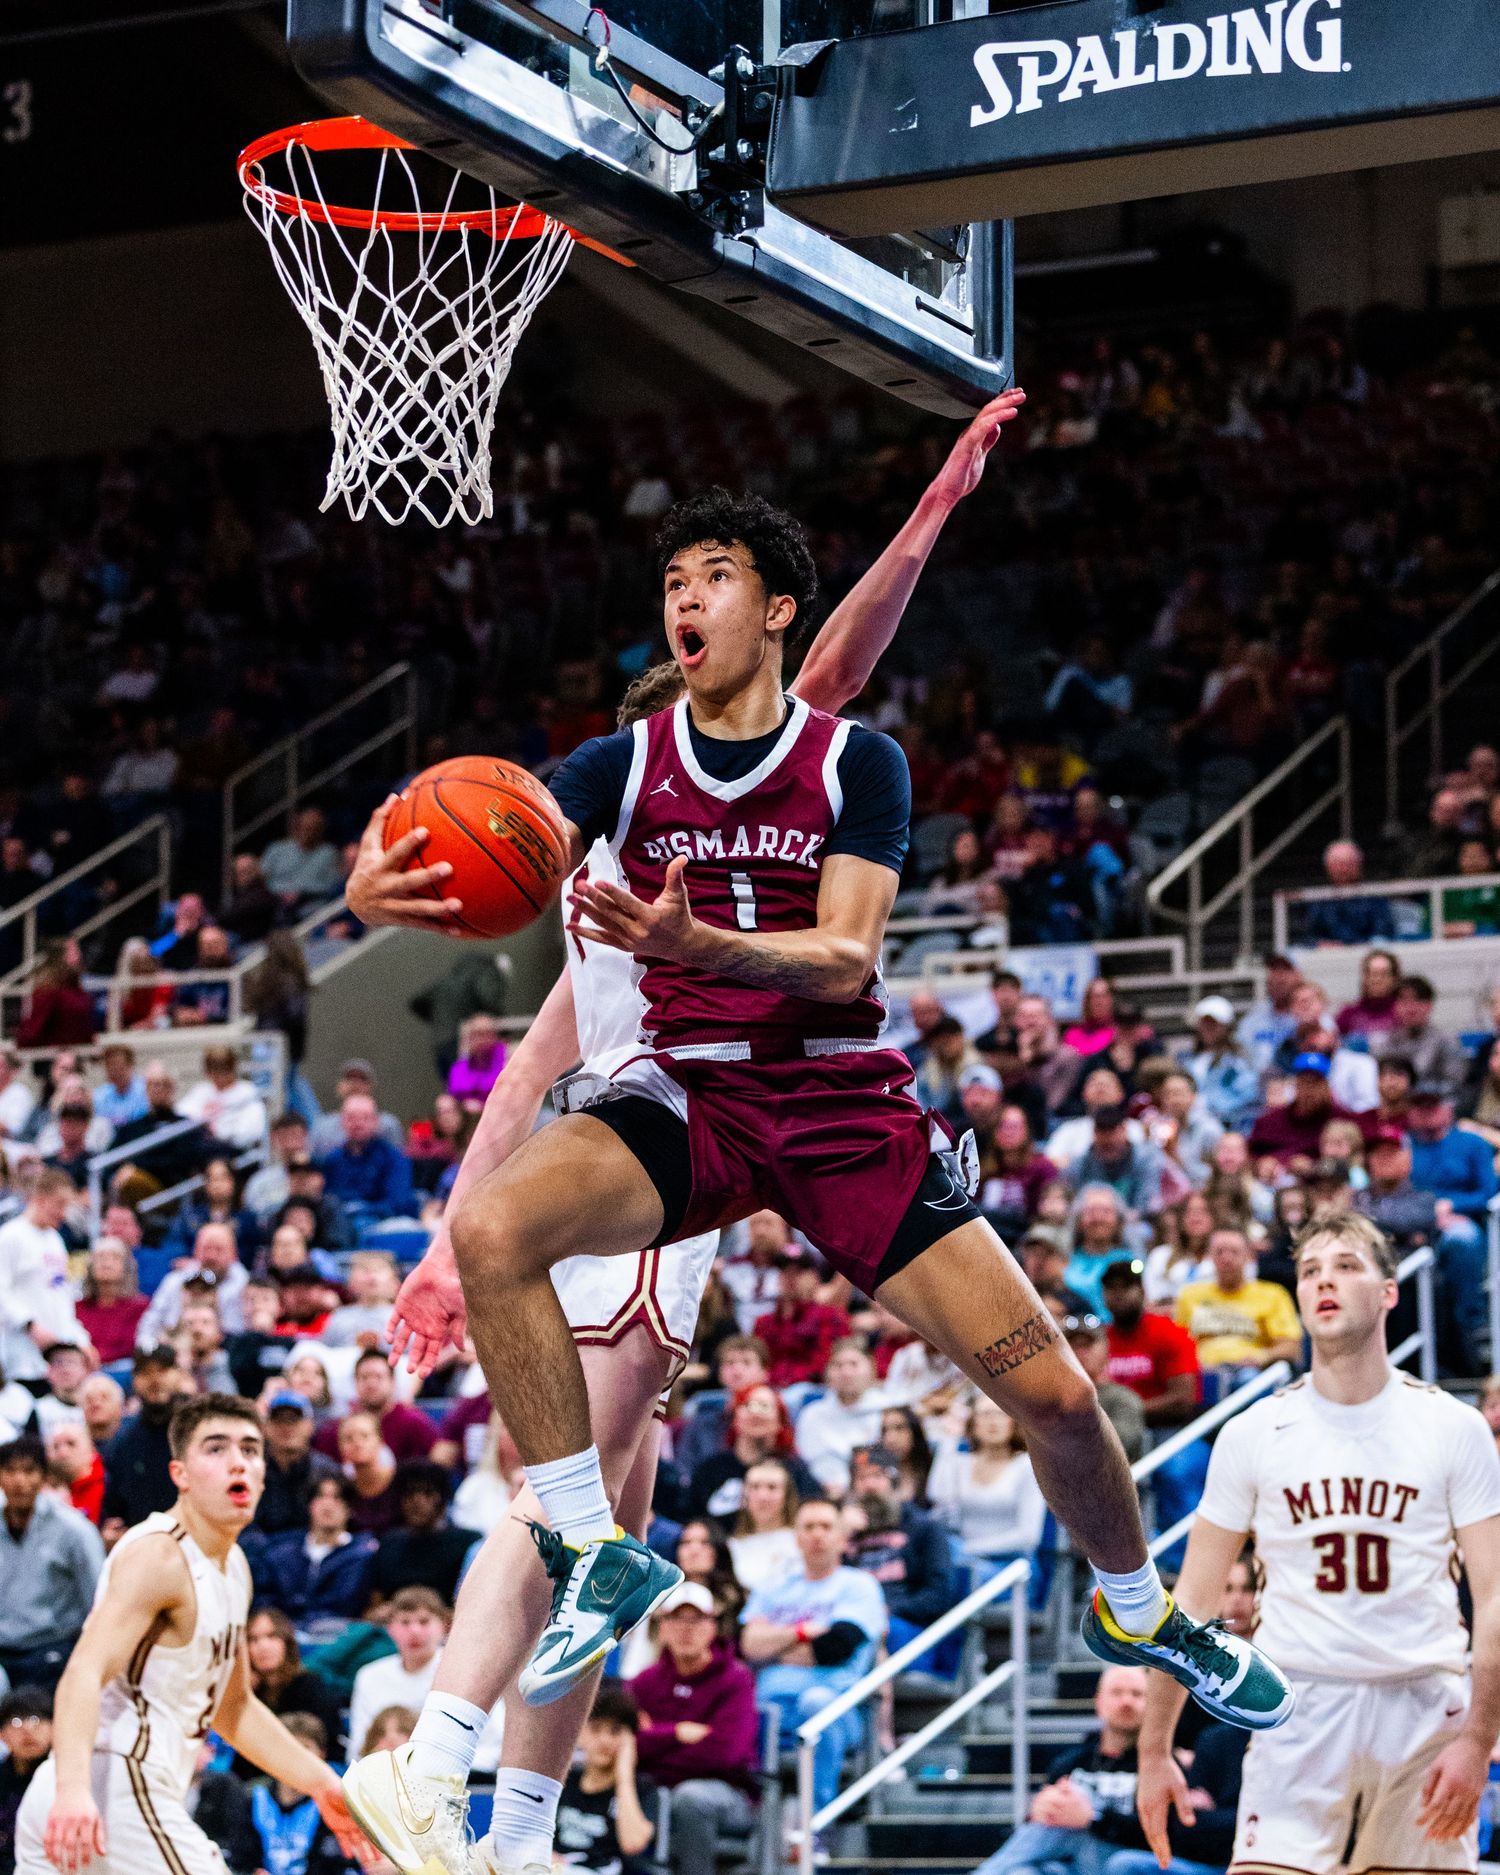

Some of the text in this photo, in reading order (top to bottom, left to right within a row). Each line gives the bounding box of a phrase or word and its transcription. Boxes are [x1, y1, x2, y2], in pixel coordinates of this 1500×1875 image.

[970, 0, 1341, 127] SPALDING
[643, 825, 825, 869] BISMARCK
[730, 872, 758, 930] 1
[1283, 1477, 1420, 1525] MINOT
[1312, 1531, 1391, 1595] 30
